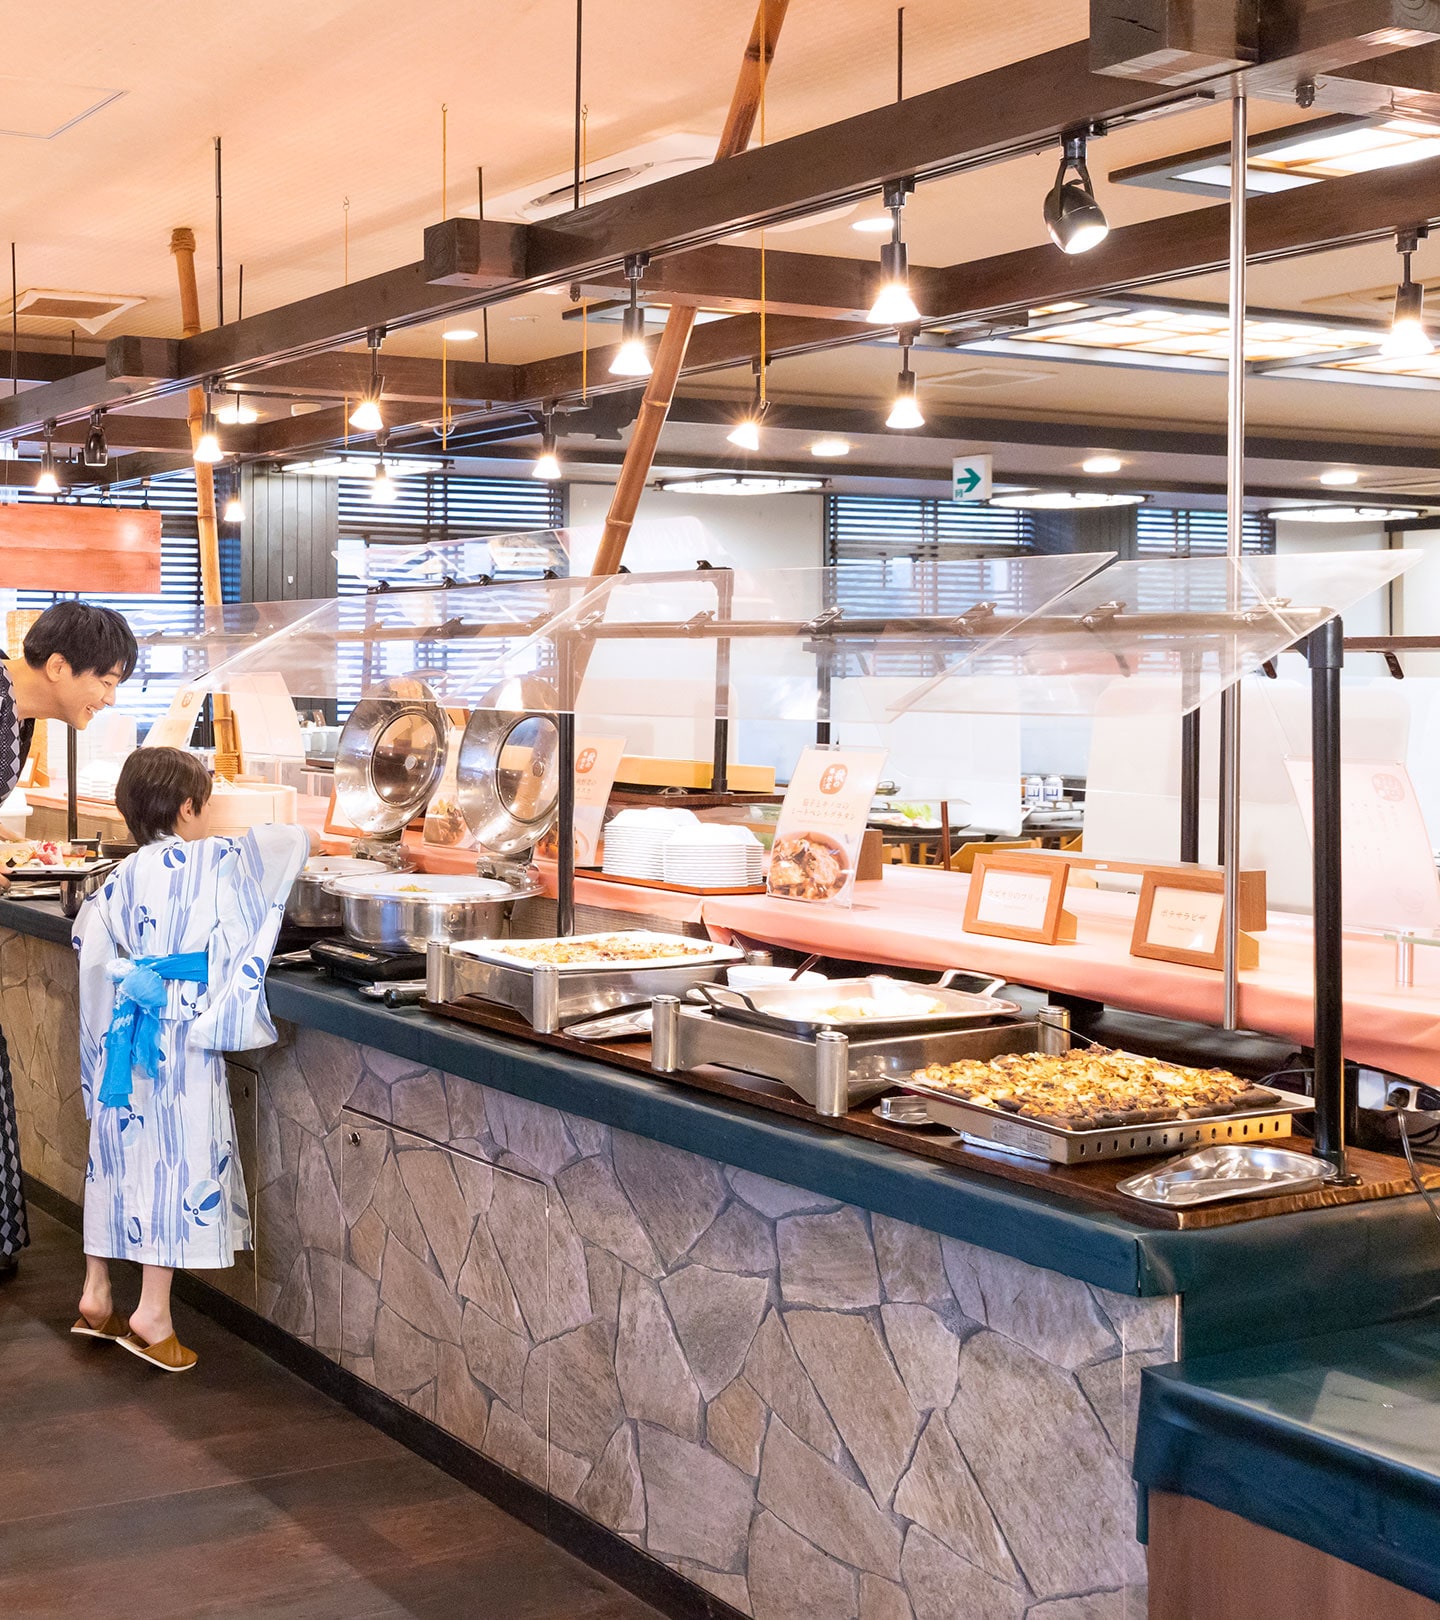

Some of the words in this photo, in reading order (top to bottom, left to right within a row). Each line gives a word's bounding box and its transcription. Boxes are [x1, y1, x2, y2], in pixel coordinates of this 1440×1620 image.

[1161, 908, 1208, 923] ポテサラピザ
